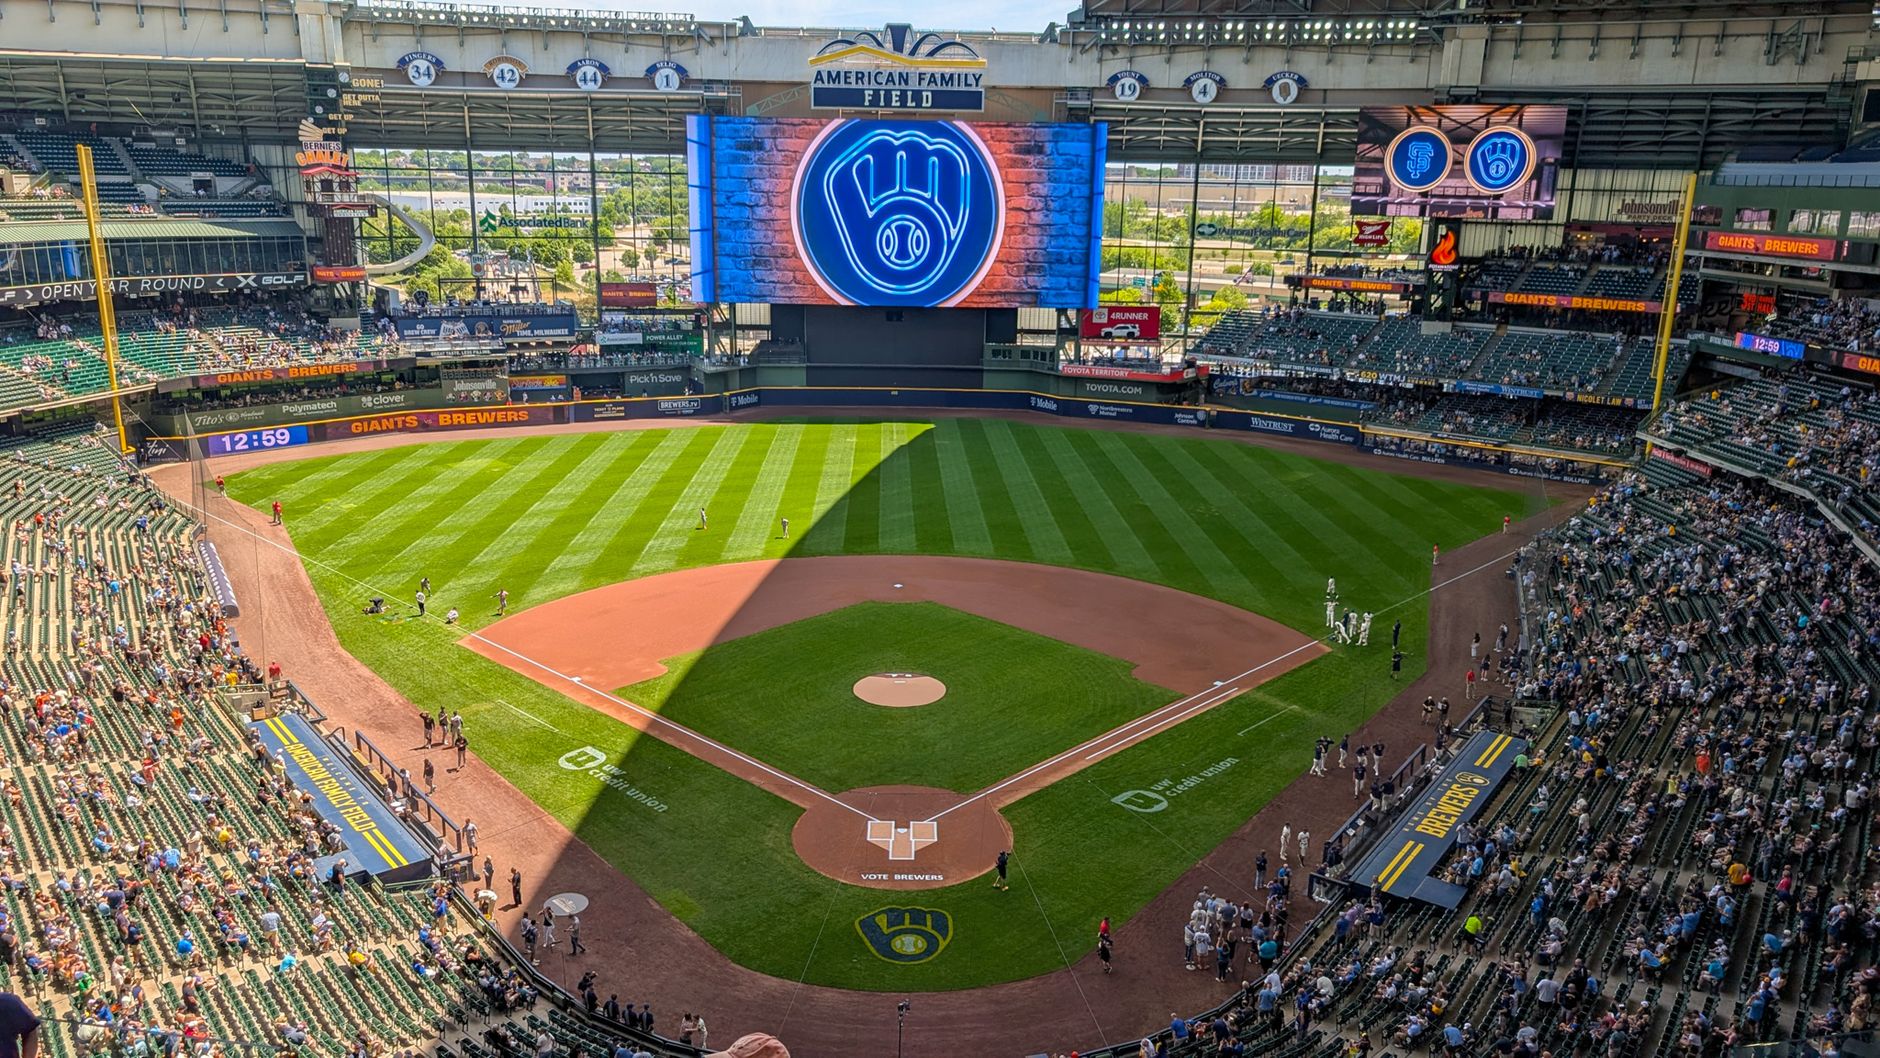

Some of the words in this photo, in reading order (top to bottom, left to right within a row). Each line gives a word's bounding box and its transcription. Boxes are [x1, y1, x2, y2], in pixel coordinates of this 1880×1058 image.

[405, 52, 437, 63] FINGERS
[411, 65, 432, 81] 34
[496, 69, 517, 83] 42
[578, 71, 599, 85] 44
[814, 70, 909, 86] AMERICAN
[918, 72, 983, 88] FAMILY
[1190, 71, 1221, 81] MOLITOR
[1272, 72, 1299, 81] UECKER
[352, 78, 384, 88] GONE!
[663, 74, 672, 88] 1
[1119, 83, 1137, 97] 19
[1198, 83, 1209, 98] 4
[864, 90, 933, 108] FIELD
[303, 142, 341, 151] BERNIE'S
[295, 151, 349, 168] CHALET
[1718, 235, 1755, 249] GIANTS
[1764, 239, 1819, 255] BREWERS
[41, 283, 83, 299] OPEN
[140, 277, 205, 291] ROUND
[262, 275, 305, 285] GOLF
[1312, 279, 1343, 287] GIANTS
[1351, 282, 1393, 291] BREWERS
[1504, 293, 1557, 305] GIANTS
[1570, 297, 1646, 311] BREWERS
[1110, 312, 1149, 321] 4RUNNER
[534, 328, 569, 336] MILWAUKEE
[1755, 339, 1780, 352] 12:59
[217, 370, 274, 384] GIANTS
[289, 363, 358, 379] BREWERS
[1064, 366, 1090, 375] TOYOTA
[1091, 368, 1129, 377] TERRITORY
[1379, 373, 1406, 382] WTMJ
[453, 379, 497, 391] Johnsonville
[630, 373, 650, 384] Pick
[658, 373, 682, 383] Save
[1085, 383, 1142, 395] TOYOTA.COM
[373, 394, 405, 406] clover
[661, 401, 698, 409] BREWERS.TV
[737, 394, 758, 407] Mobile
[1037, 397, 1058, 410] Mobile
[1577, 394, 1604, 404] NICOLET
[1607, 396, 1623, 406] LAW
[282, 401, 337, 413] Polymatech
[195, 414, 224, 427] Tito's
[351, 416, 418, 433] GIANTS
[438, 411, 529, 426] BREWERS
[1174, 412, 1194, 420] Johnson
[1177, 417, 1197, 425] Controls
[1250, 416, 1294, 431] WINTRUST
[1321, 426, 1340, 434] Aurora
[221, 429, 290, 452] 12:59
[1320, 432, 1339, 440] Health
[1340, 434, 1354, 442] Care
[1422, 456, 1445, 464] BULLPEN
[1563, 476, 1589, 484] BULLPEN
[602, 764, 627, 776] uw
[1165, 775, 1205, 797] credit
[1200, 756, 1241, 777] union
[284, 743, 333, 785] AMERICAN
[317, 774, 353, 809] FAMILY
[340, 801, 377, 832] FIELD
[588, 769, 630, 790] credit
[626, 788, 669, 813] union
[1150, 778, 1174, 791] uw
[1415, 784, 1480, 839] BREWERS
